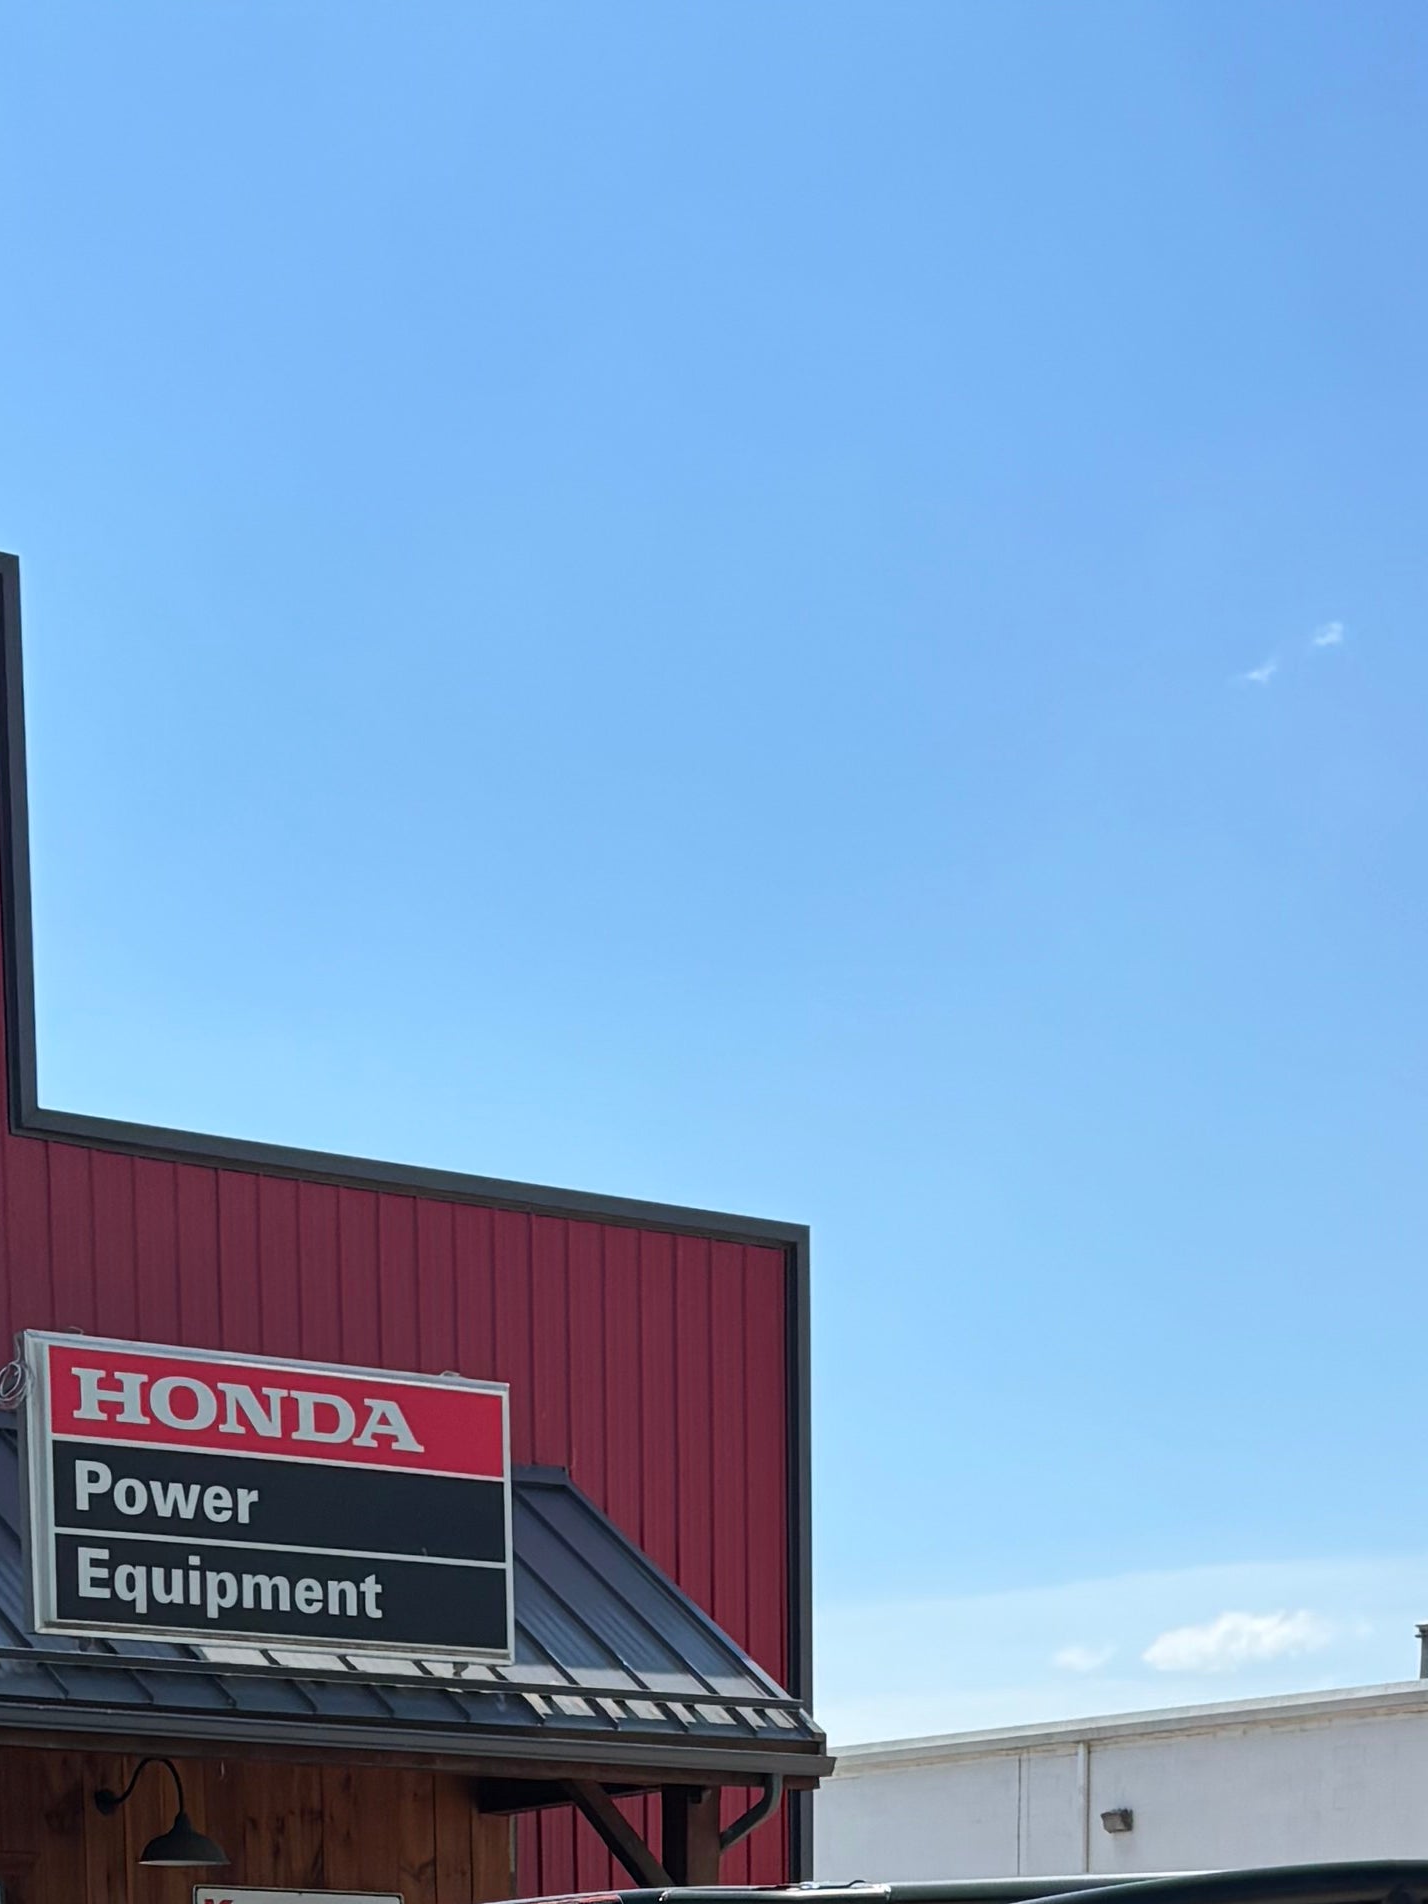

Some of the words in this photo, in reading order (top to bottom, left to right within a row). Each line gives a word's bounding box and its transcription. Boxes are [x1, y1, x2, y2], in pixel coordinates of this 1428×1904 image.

[71, 1367, 425, 1453] HONDA
[75, 1459, 259, 1524] Power
[77, 1547, 383, 1619] Equipment
